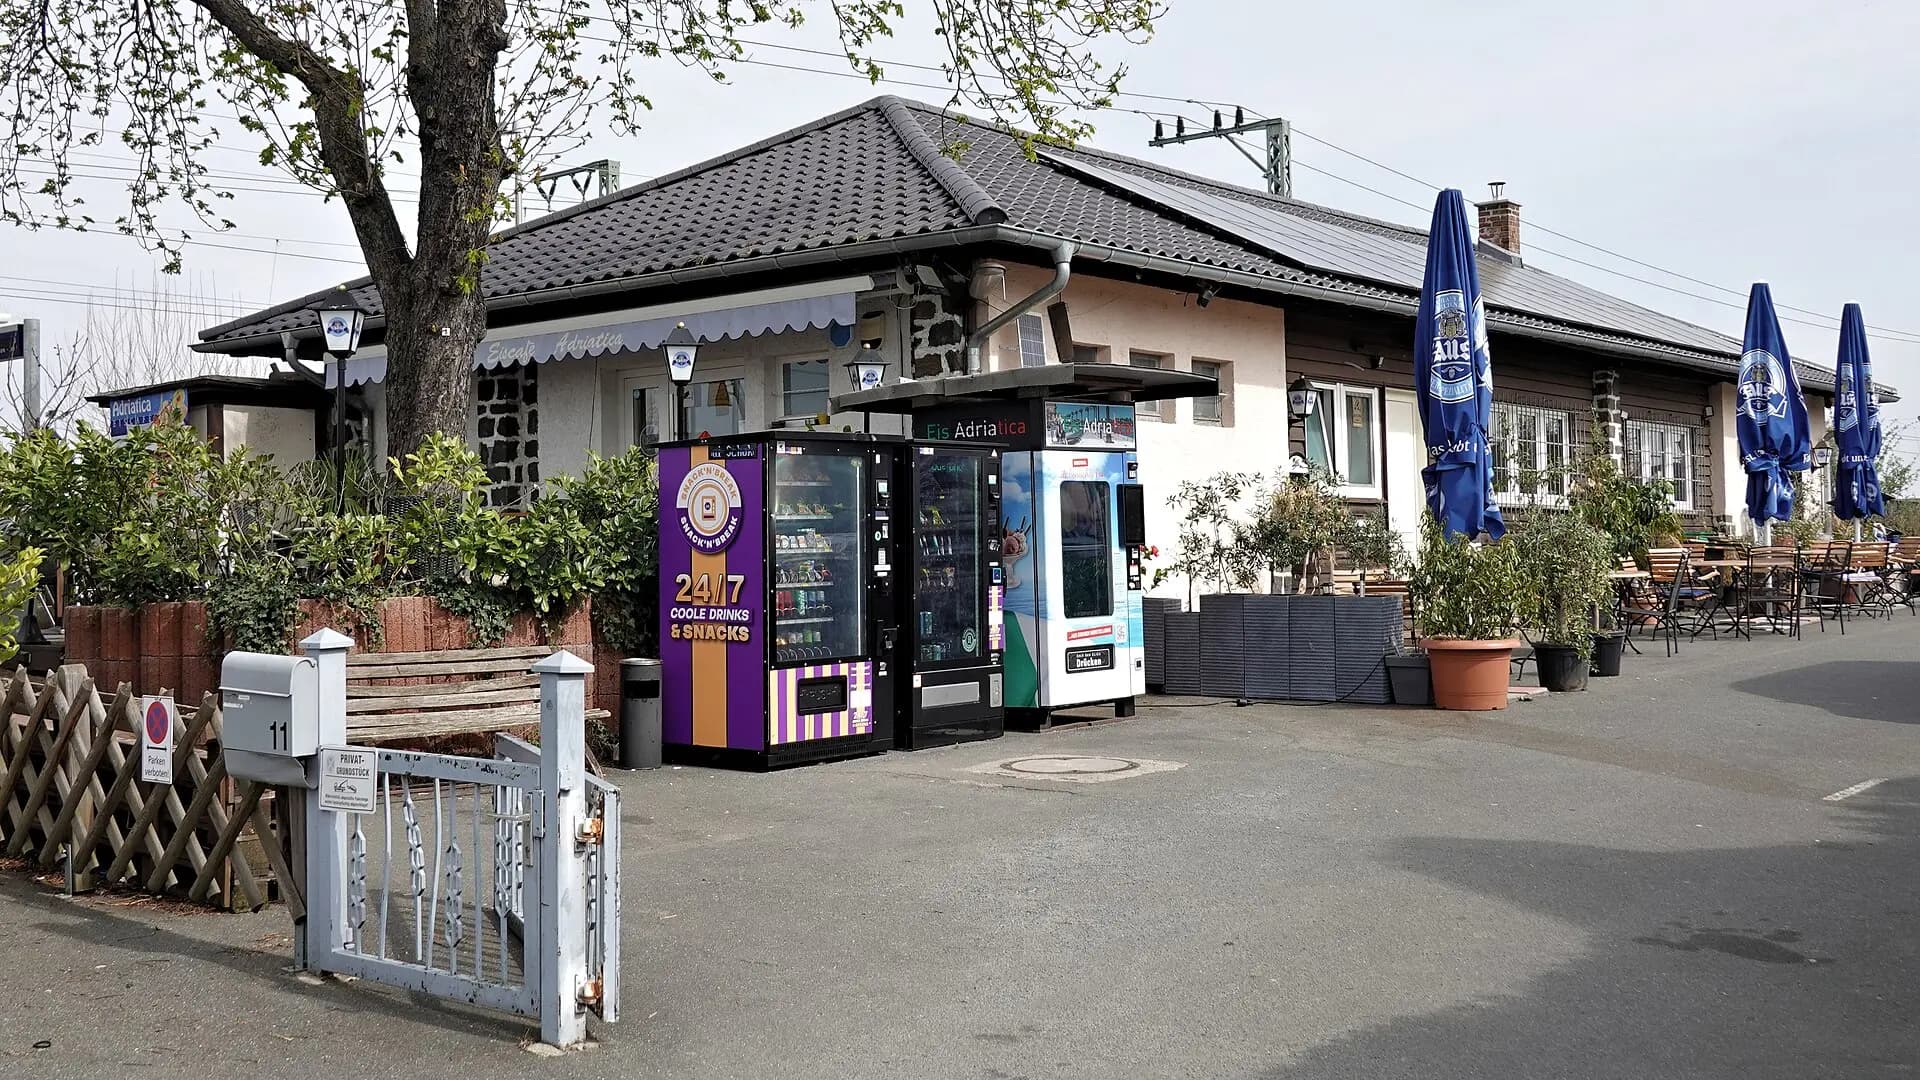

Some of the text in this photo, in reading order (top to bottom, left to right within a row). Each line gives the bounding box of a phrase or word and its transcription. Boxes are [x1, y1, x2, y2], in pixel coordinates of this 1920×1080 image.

[553, 333, 624, 355] Adriatica
[112, 398, 152, 417] Adriatica
[927, 419, 1026, 440] Eis Adriatica
[675, 573, 745, 603] 24/7
[670, 607, 750, 621] COOLE DRINKS
[671, 623, 750, 642] & SNACKS
[1076, 656, 1102, 668] Drücken
[269, 720, 287, 751] 11
[340, 754, 365, 764] PRIVAT-
[336, 766, 369, 776] GRUNDSTÜCK
